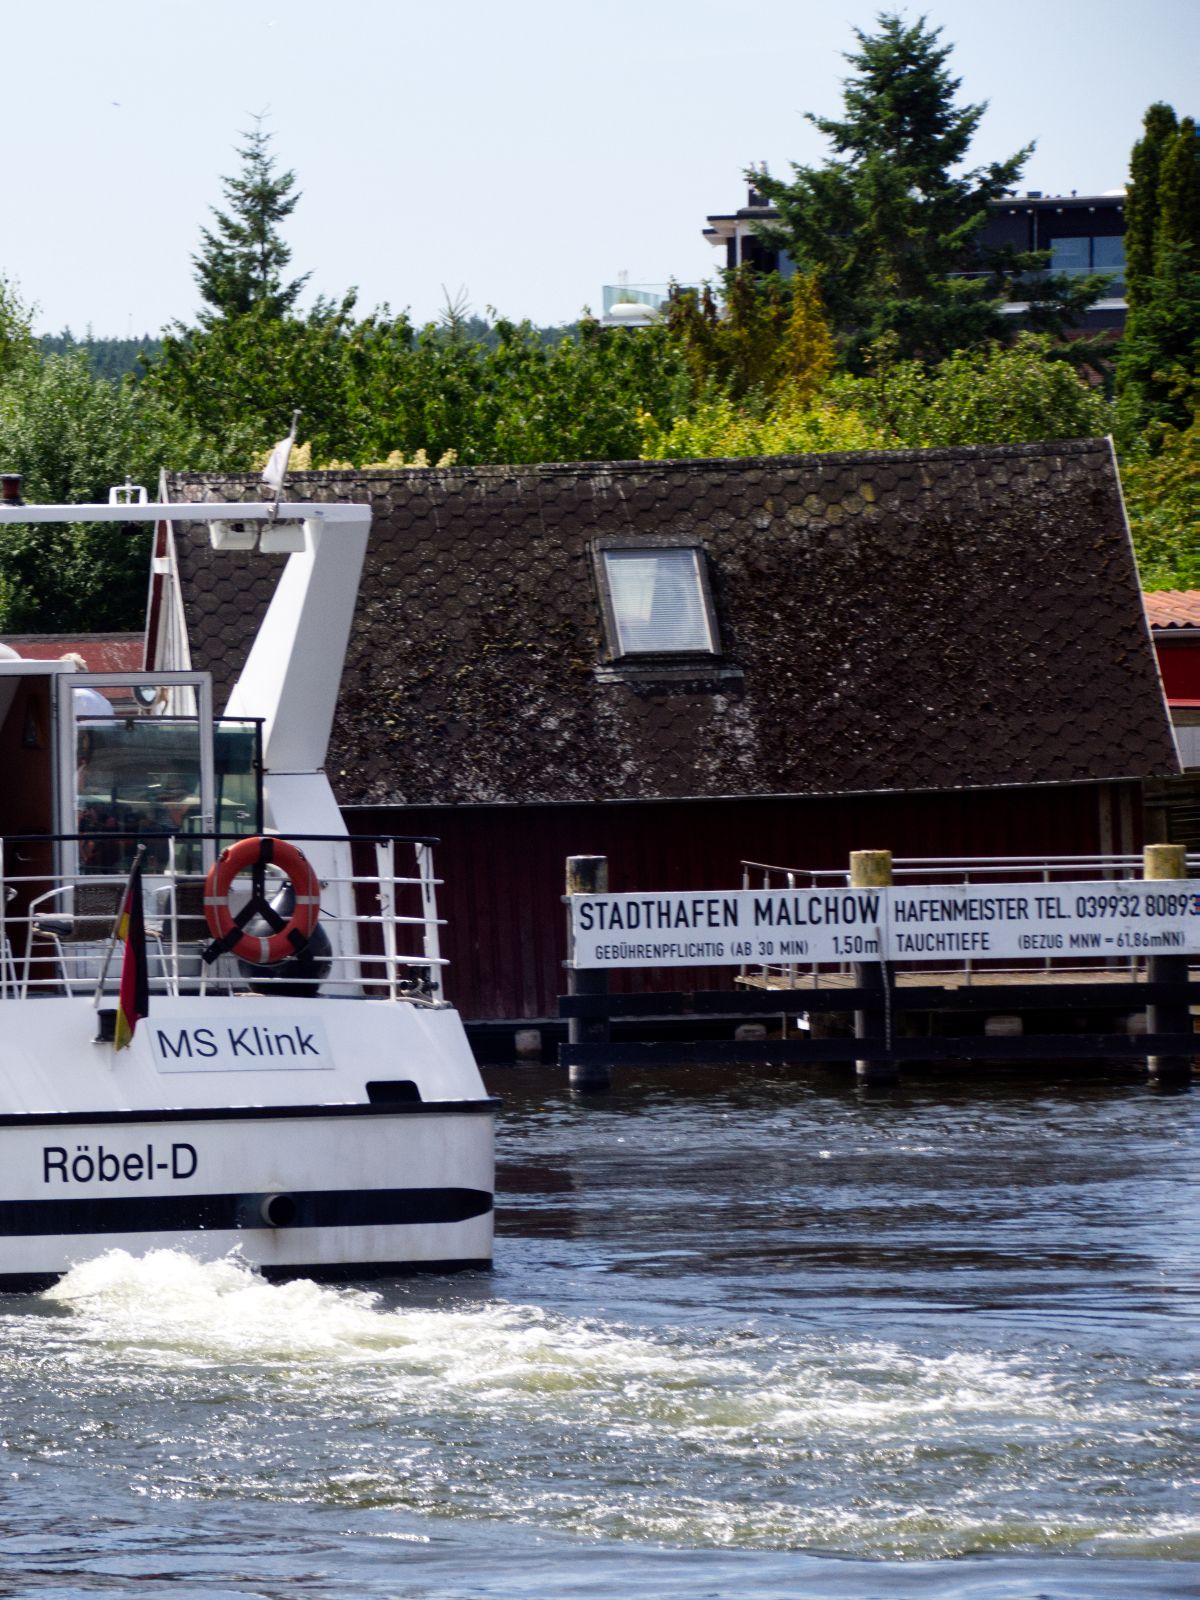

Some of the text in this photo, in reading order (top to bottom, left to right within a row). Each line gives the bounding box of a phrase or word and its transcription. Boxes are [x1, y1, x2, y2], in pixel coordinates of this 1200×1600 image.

[579, 895, 880, 930] STADTHAFEN MALCHOW
[895, 896, 1029, 922] HAFENMEISTER
[1035, 896, 1071, 919] TEL.
[1076, 894, 1140, 919] 039932
[595, 939, 809, 960] GEBÜHRENPFLICHTIG (AB 30 MIN)
[896, 932, 991, 952] TAUCHTIEFE
[1018, 932, 1063, 950] (BEZUG
[1070, 932, 1100, 949] MNW
[156, 1026, 320, 1058] MS Klink
[43, 1142, 198, 1184] Röbel-D
